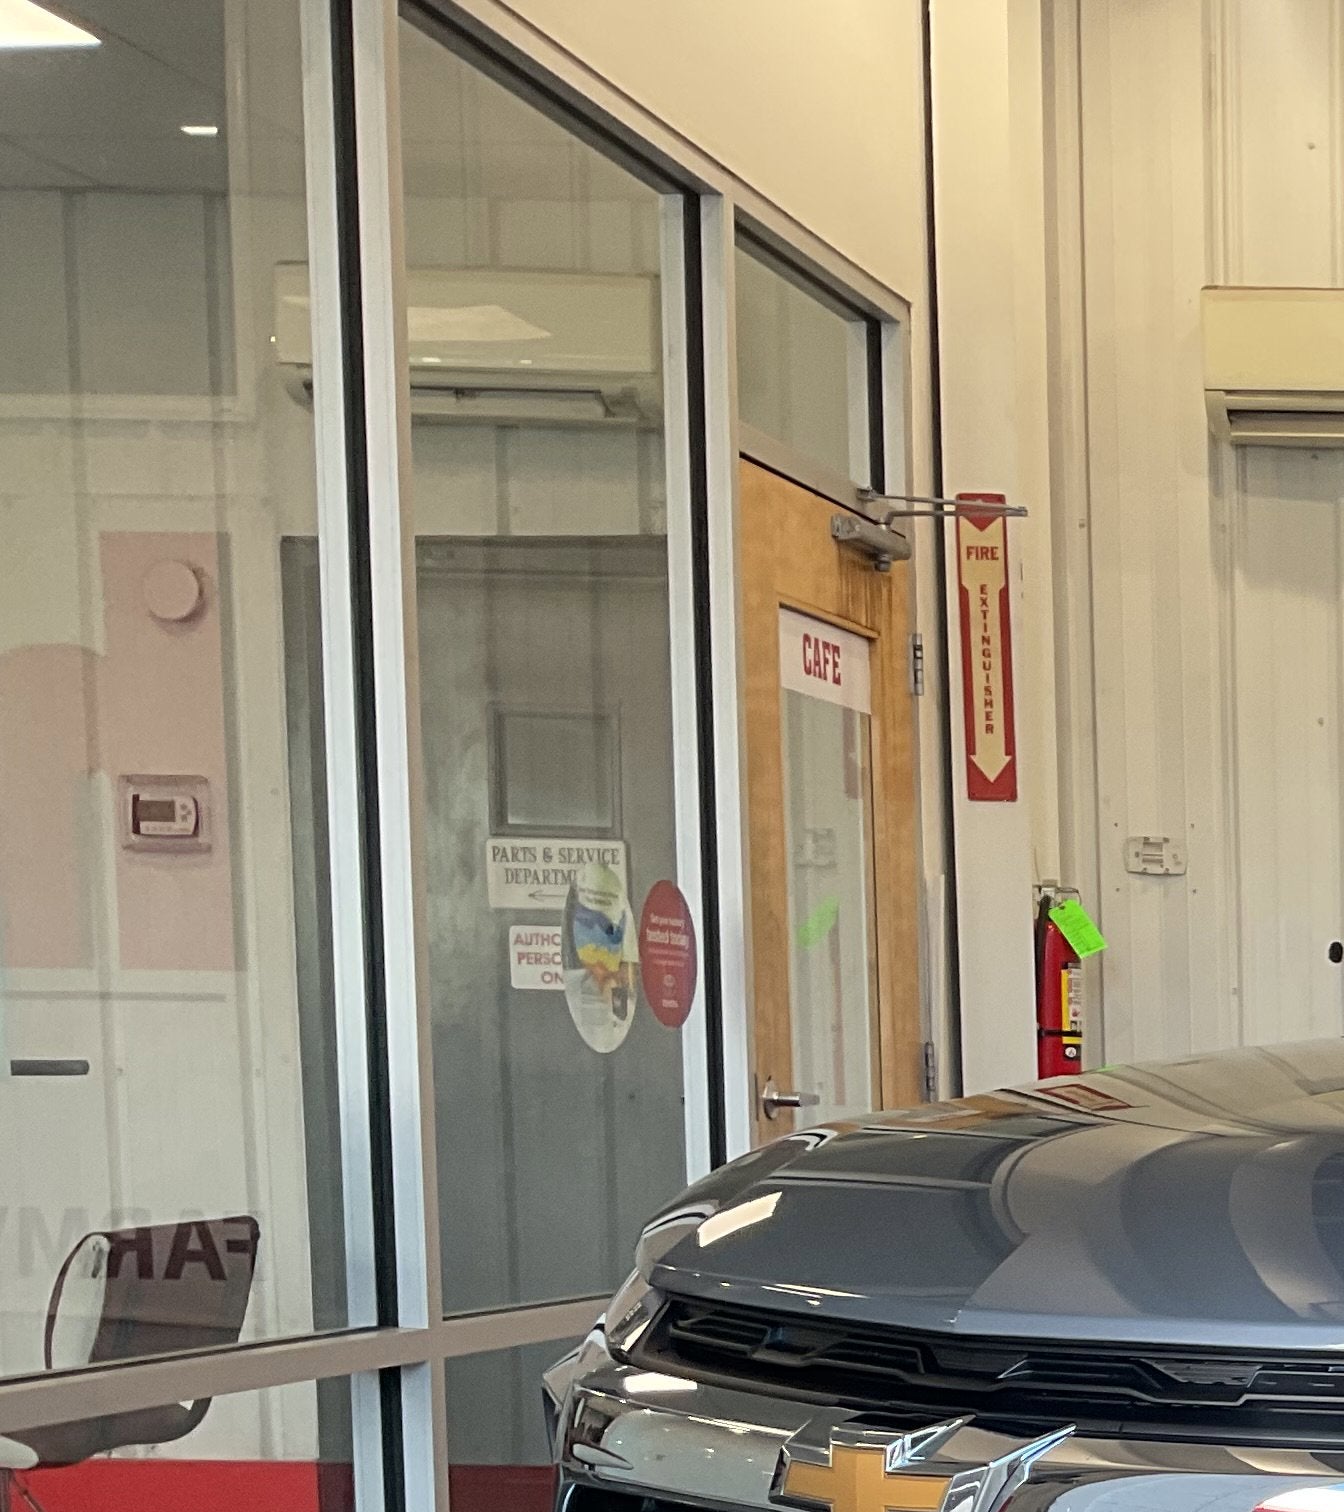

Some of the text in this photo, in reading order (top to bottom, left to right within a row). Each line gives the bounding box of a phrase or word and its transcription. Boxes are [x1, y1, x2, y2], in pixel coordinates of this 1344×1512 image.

[966, 545, 1000, 561] FIRE
[802, 632, 842, 687] CAFE
[980, 584, 994, 735] EXTINGUISHER
[491, 846, 620, 866] PARTS & SERVICE
[513, 932, 561, 947] AUTHO
[517, 951, 562, 966] PERSO
[541, 971, 564, 985] ON
